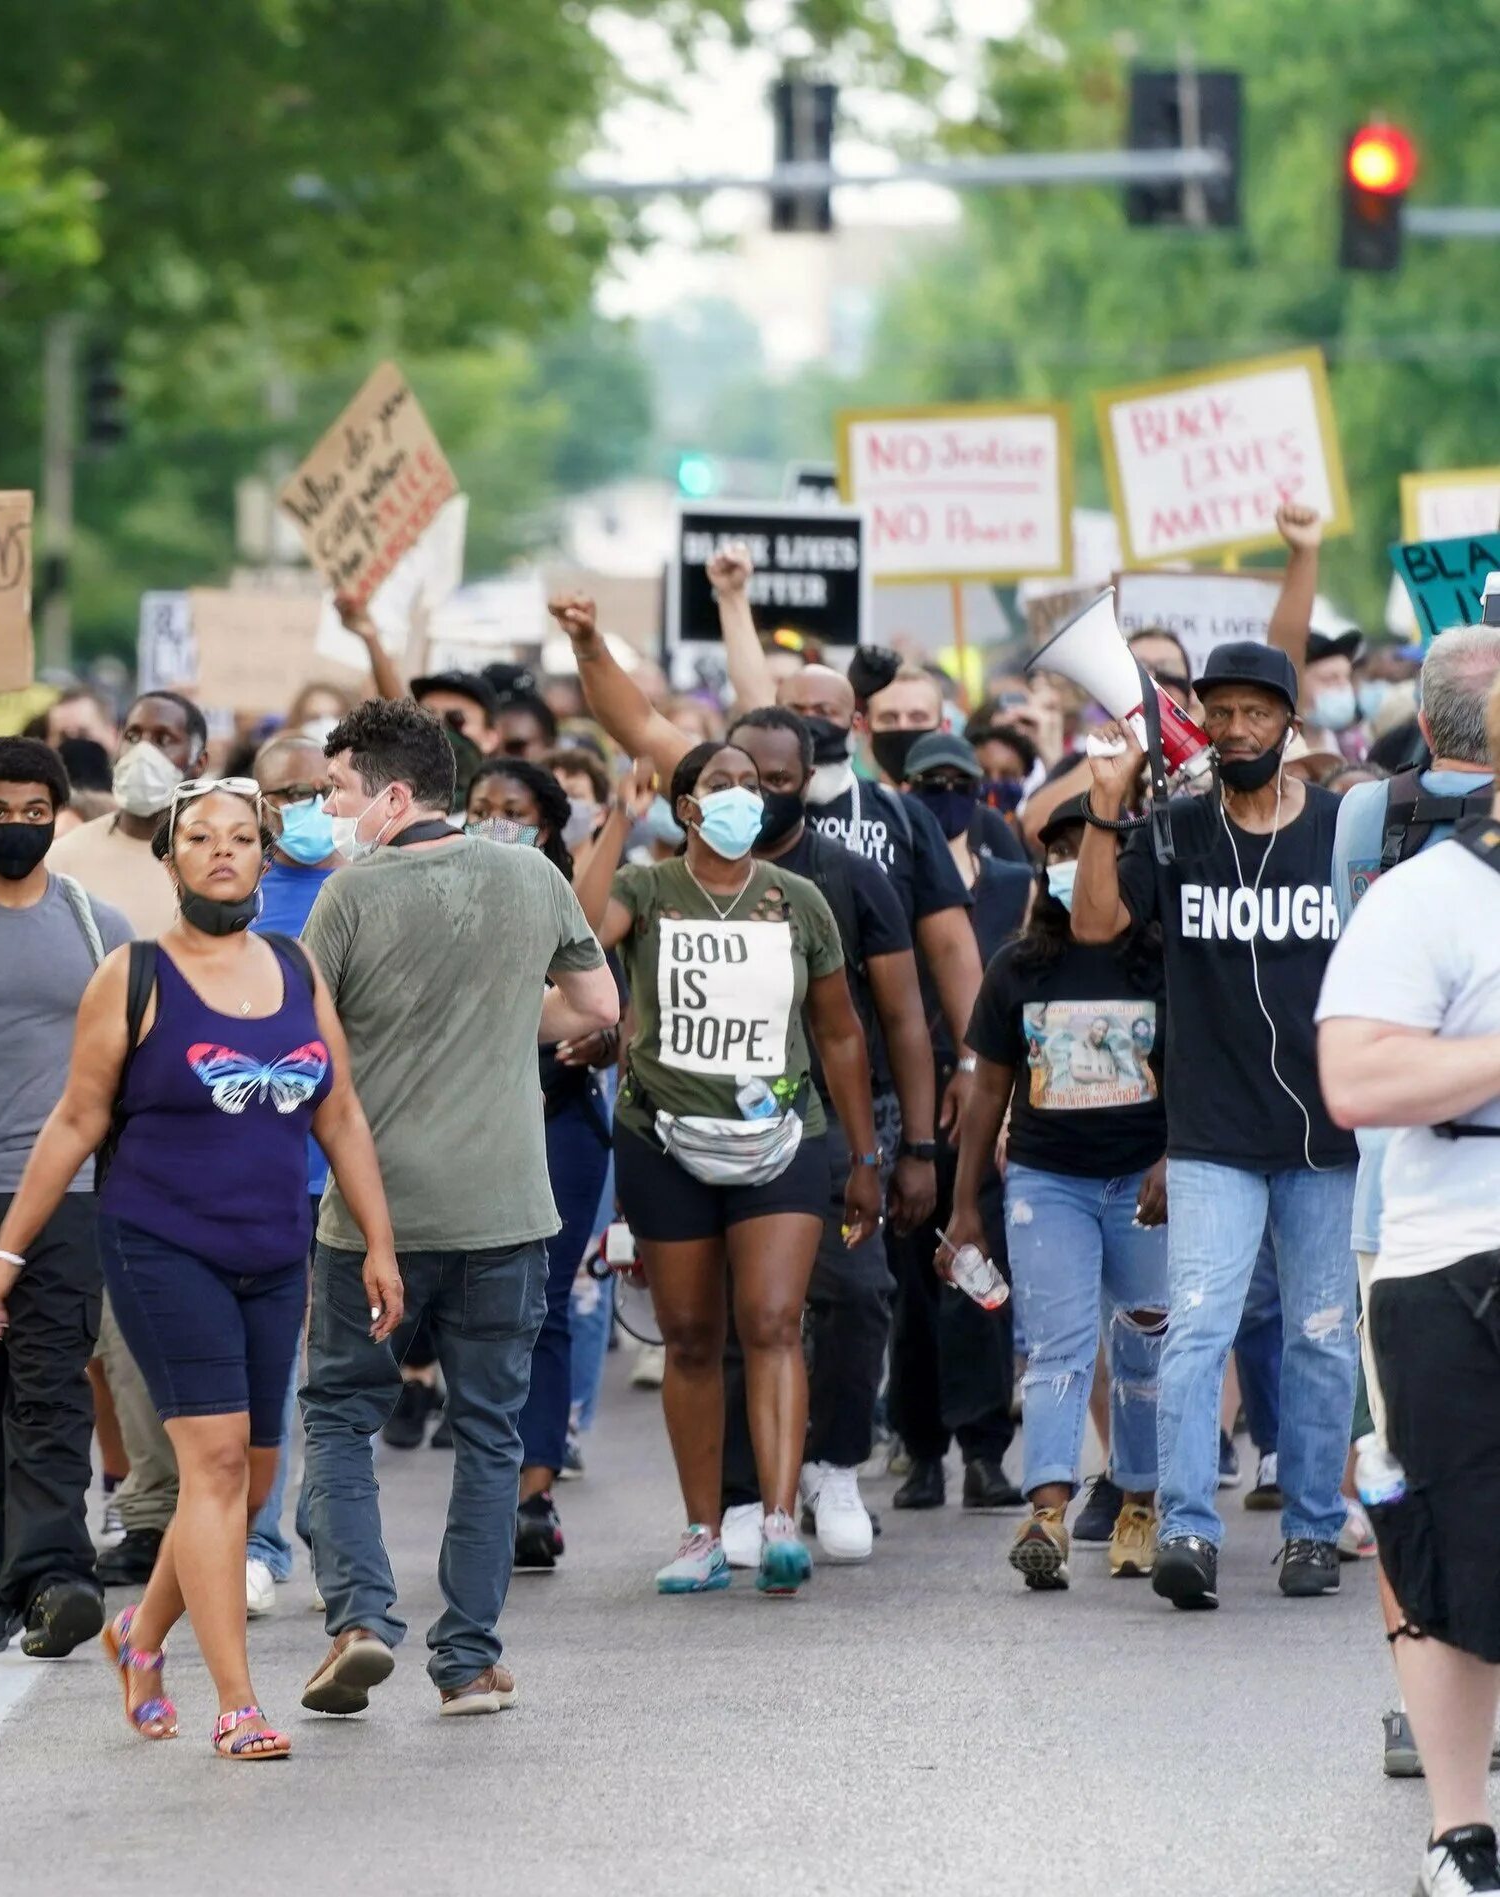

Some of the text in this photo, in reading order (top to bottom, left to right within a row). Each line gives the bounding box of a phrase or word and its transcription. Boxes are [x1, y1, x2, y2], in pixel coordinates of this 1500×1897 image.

[1130, 397, 1233, 456] BLACK
[867, 433, 932, 475] NO
[1182, 429, 1304, 490] LIVES
[872, 503, 930, 548] NO
[682, 531, 859, 571] BLK LIVES
[811, 816, 888, 842] YOU TO
[1180, 883, 1341, 942] ENOUGH
[672, 931, 749, 964] GOD
[670, 967, 707, 1010] IS
[671, 1012, 773, 1063] DOPE.
